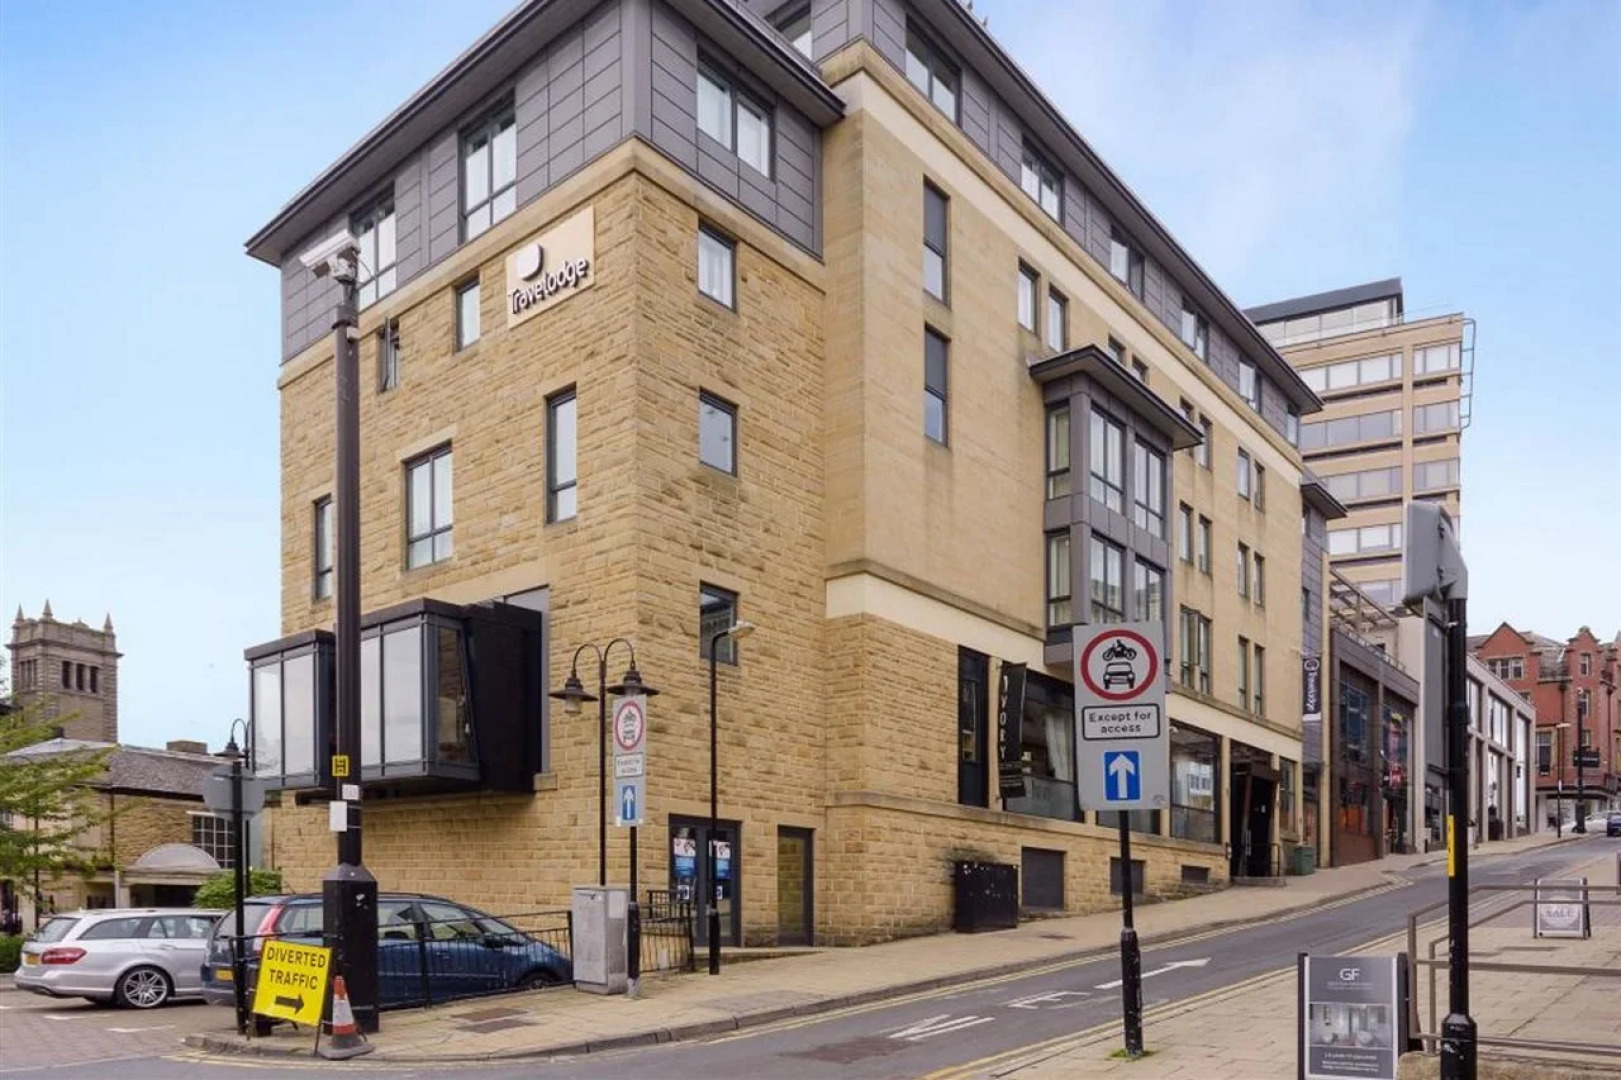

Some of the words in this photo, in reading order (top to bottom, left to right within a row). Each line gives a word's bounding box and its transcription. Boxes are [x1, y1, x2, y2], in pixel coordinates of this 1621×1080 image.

[512, 257, 589, 314] Travelodge
[1088, 711, 1131, 723] Except
[1134, 710, 1152, 721] for
[1101, 724, 1142, 734] access
[266, 946, 326, 968] DIVERTED
[269, 968, 318, 990] TRAFFIC
[1339, 967, 1361, 981] GF
